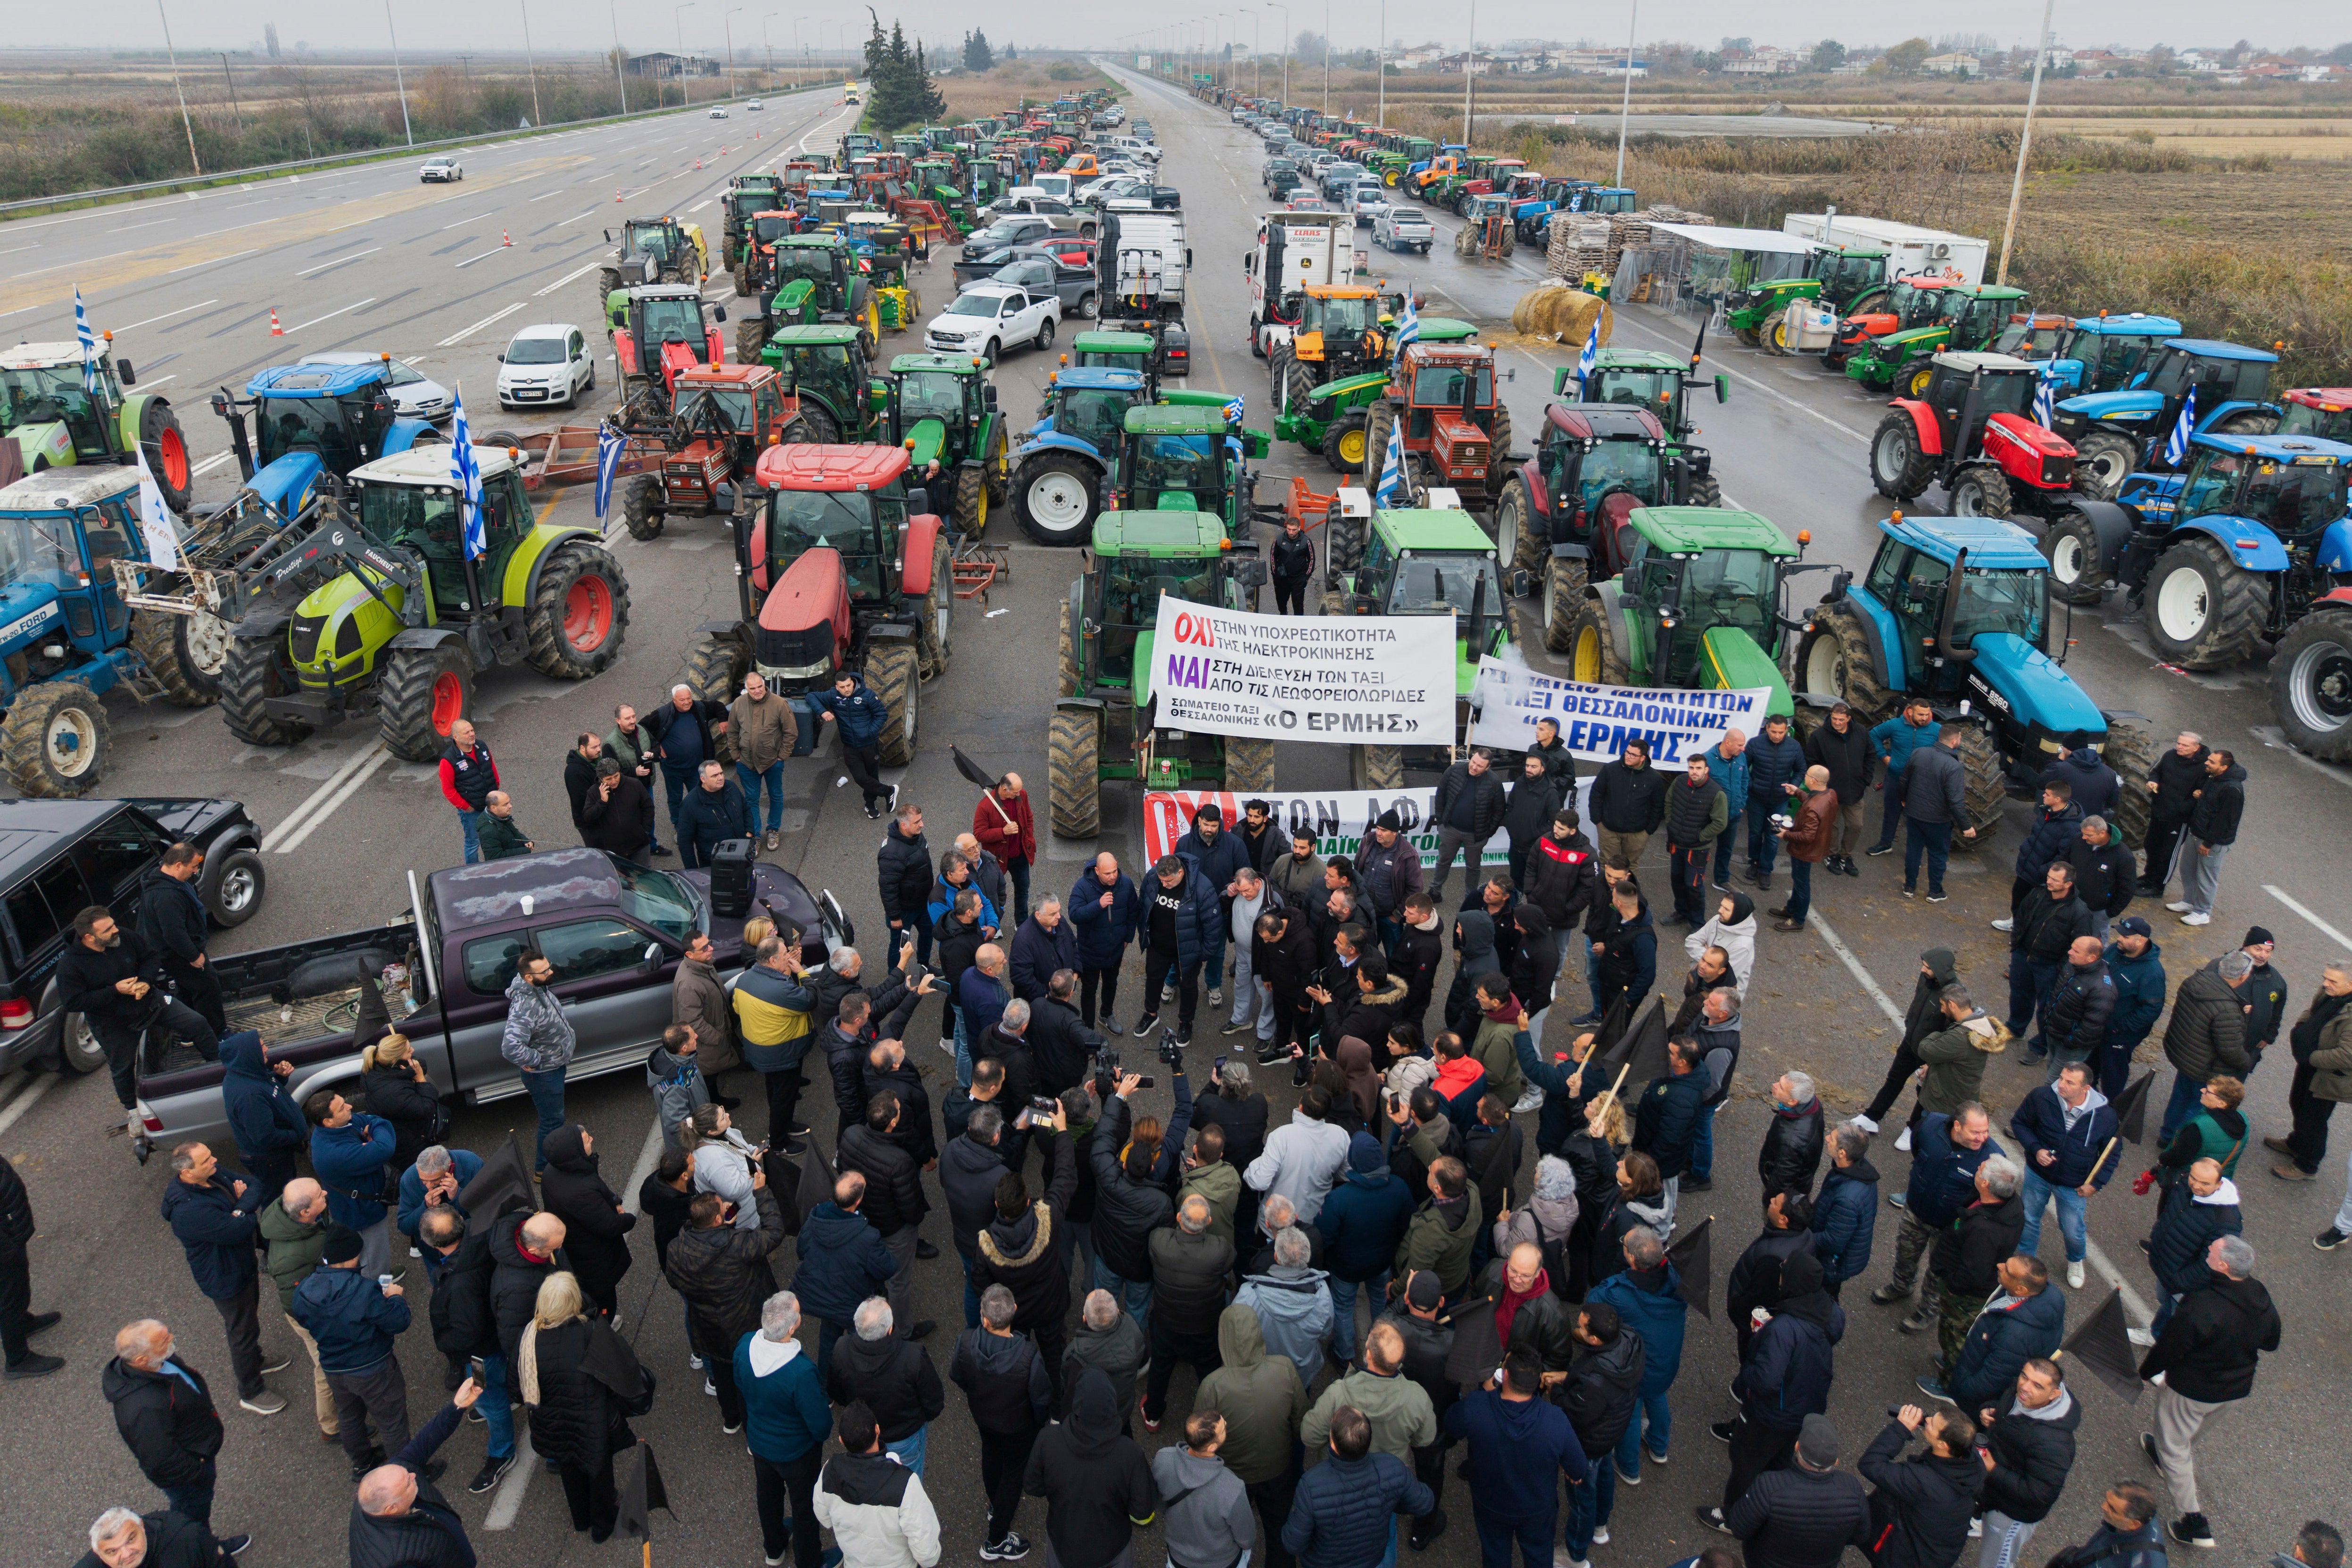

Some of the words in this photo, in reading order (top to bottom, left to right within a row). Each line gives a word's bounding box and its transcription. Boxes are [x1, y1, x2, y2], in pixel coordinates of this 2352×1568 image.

[57, 433, 69, 448] CLAAS
[1177, 454, 1195, 462] Holland
[276, 556, 302, 581] Prestige
[365, 549, 394, 572] FAUCHEUX
[350, 589, 372, 606] CLAA
[20, 611, 47, 632] FORD
[1175, 612, 1214, 647] ΟΧΙ
[1213, 620, 1246, 636] ΣΤΗΝ
[1251, 625, 1396, 642] ΥΠΟΧΡΕΩΤΙΚΟΤΗΤΑ
[1216, 637, 1240, 652] ΤΗΣ
[1243, 642, 1374, 660] ΗΛΕΚΤΡΟΚΙΝΗΣΗΣ
[1168, 654, 1210, 689] ΝΑΙ
[1212, 659, 1242, 675] ΣΤΗ
[1245, 664, 1311, 682] ΔΙΕΛΕΥΣΗ
[1317, 670, 1346, 683] ΤΩΝ
[1351, 672, 1383, 684] ΤΑΞΙ
[1209, 678, 1242, 693] ΑΠΟ
[1248, 682, 1269, 697] ΤΙΣ
[1272, 685, 1425, 702] ΛΕΩΦΟΡΕΙΟΛΩΡΙΔΕΣ
[1975, 679, 1988, 692] HOLLAND
[1989, 690, 2008, 709] 8560
[1172, 698, 1230, 712] ΣΩΜΑΤΕΙΟ
[1234, 704, 1259, 715] ΤΑΞΙ
[1563, 695, 1730, 730] ΘΕΣΣΑΛΟΝΙΚΗΣ
[1171, 709, 1259, 726] ΘΕΣΣΑΛΟΝΙΚΗΣ
[1307, 712, 1419, 733] ΕΡΜΗΣ»
[1314, 836, 1362, 855] ΛΑΪΚ
